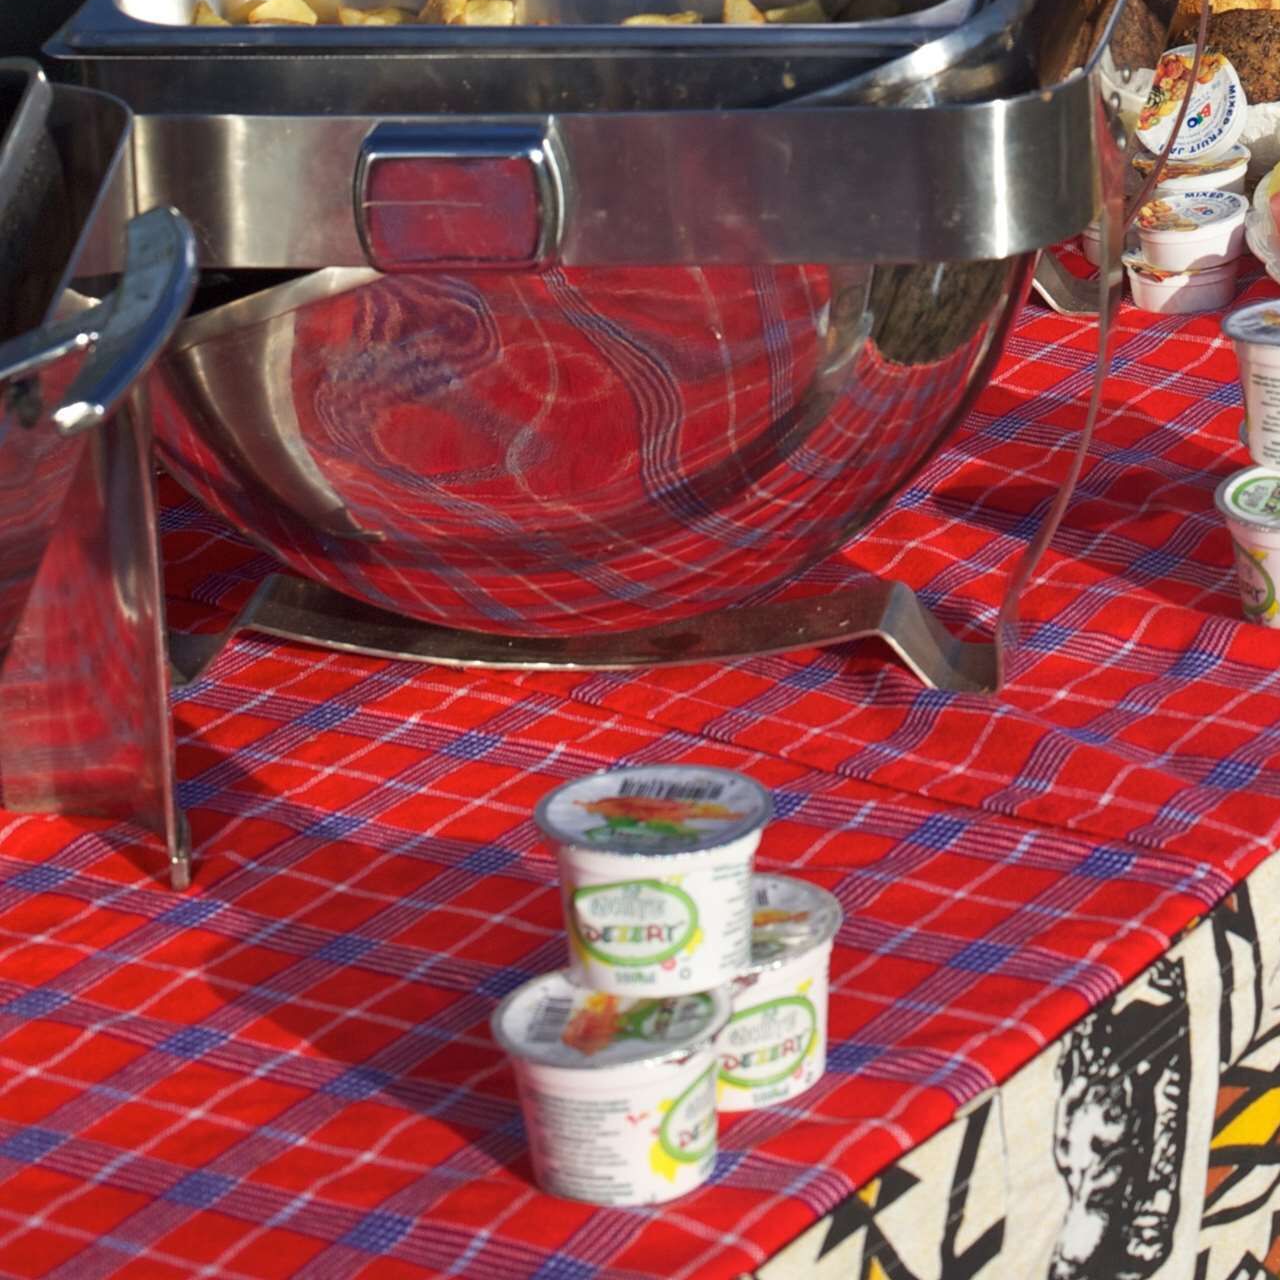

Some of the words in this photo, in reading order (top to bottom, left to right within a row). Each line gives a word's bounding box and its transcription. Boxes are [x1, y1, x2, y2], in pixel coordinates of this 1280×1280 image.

[1223, 84, 1237, 125] MIXED
[1189, 128, 1224, 154] FRUIT
[1184, 191, 1225, 199] MIXED
